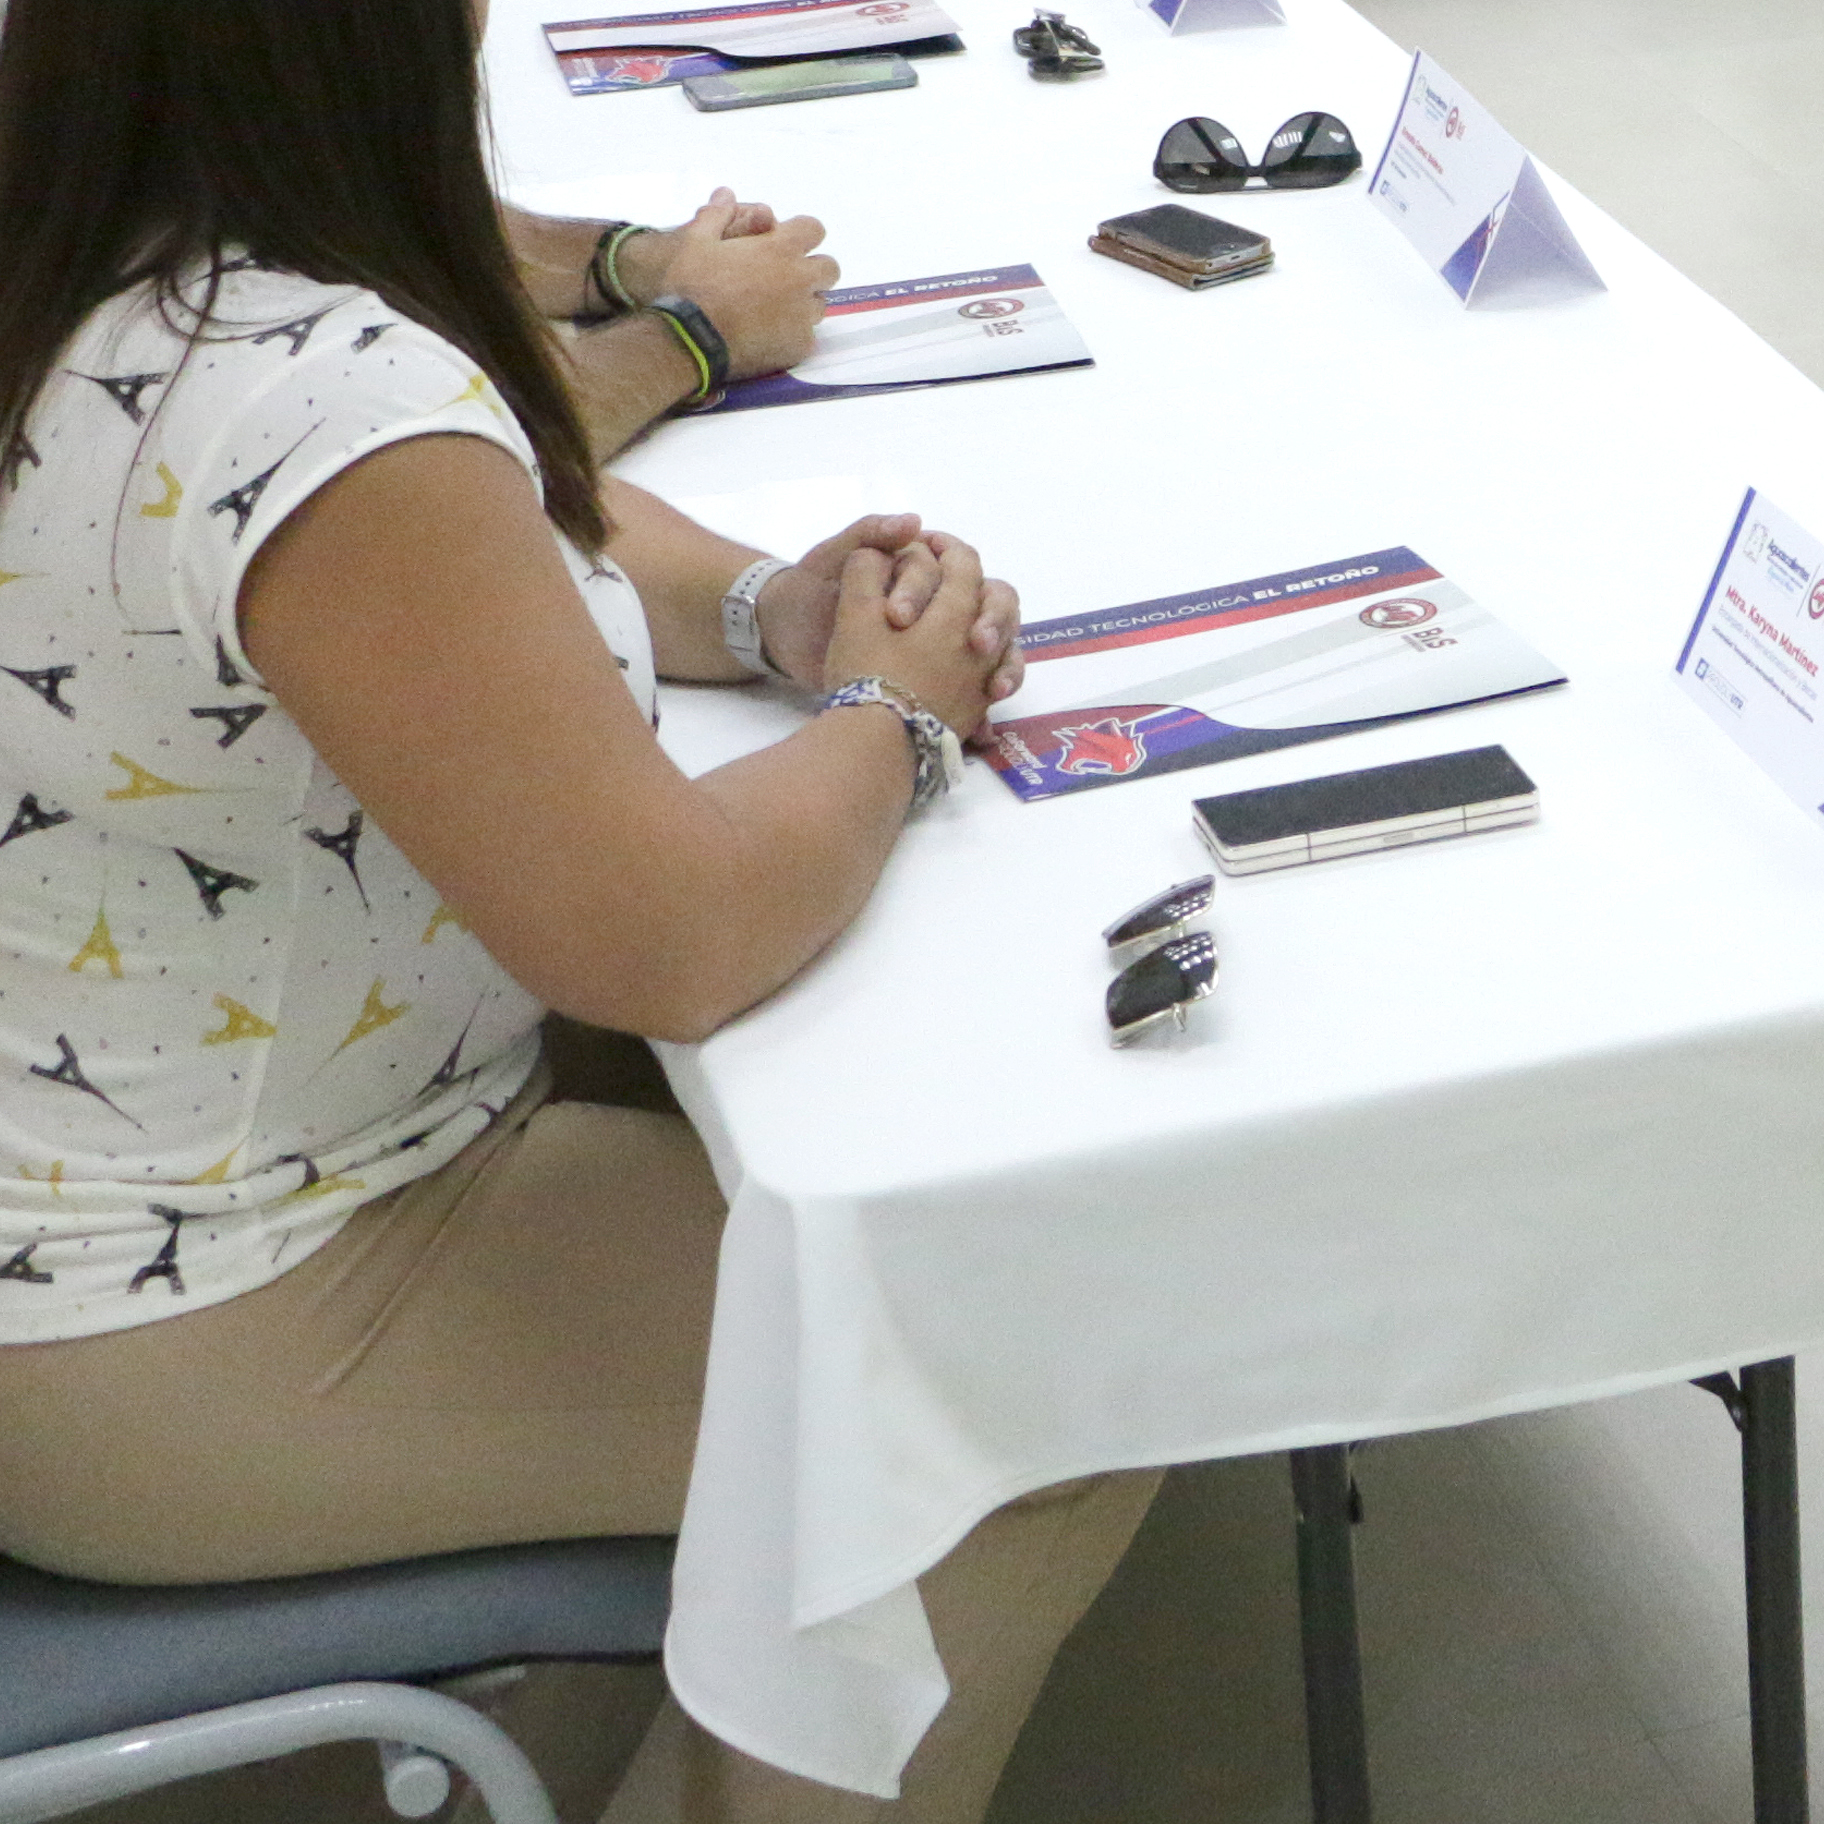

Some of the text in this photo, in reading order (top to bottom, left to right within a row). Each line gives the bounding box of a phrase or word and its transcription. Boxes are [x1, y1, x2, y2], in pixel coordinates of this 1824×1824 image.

[885, 274, 999, 297] EL RETOÑO
[1088, 564, 1381, 634] TECNOLÓGICA EL RETOÑO
[1748, 604, 1780, 643] Karyna
